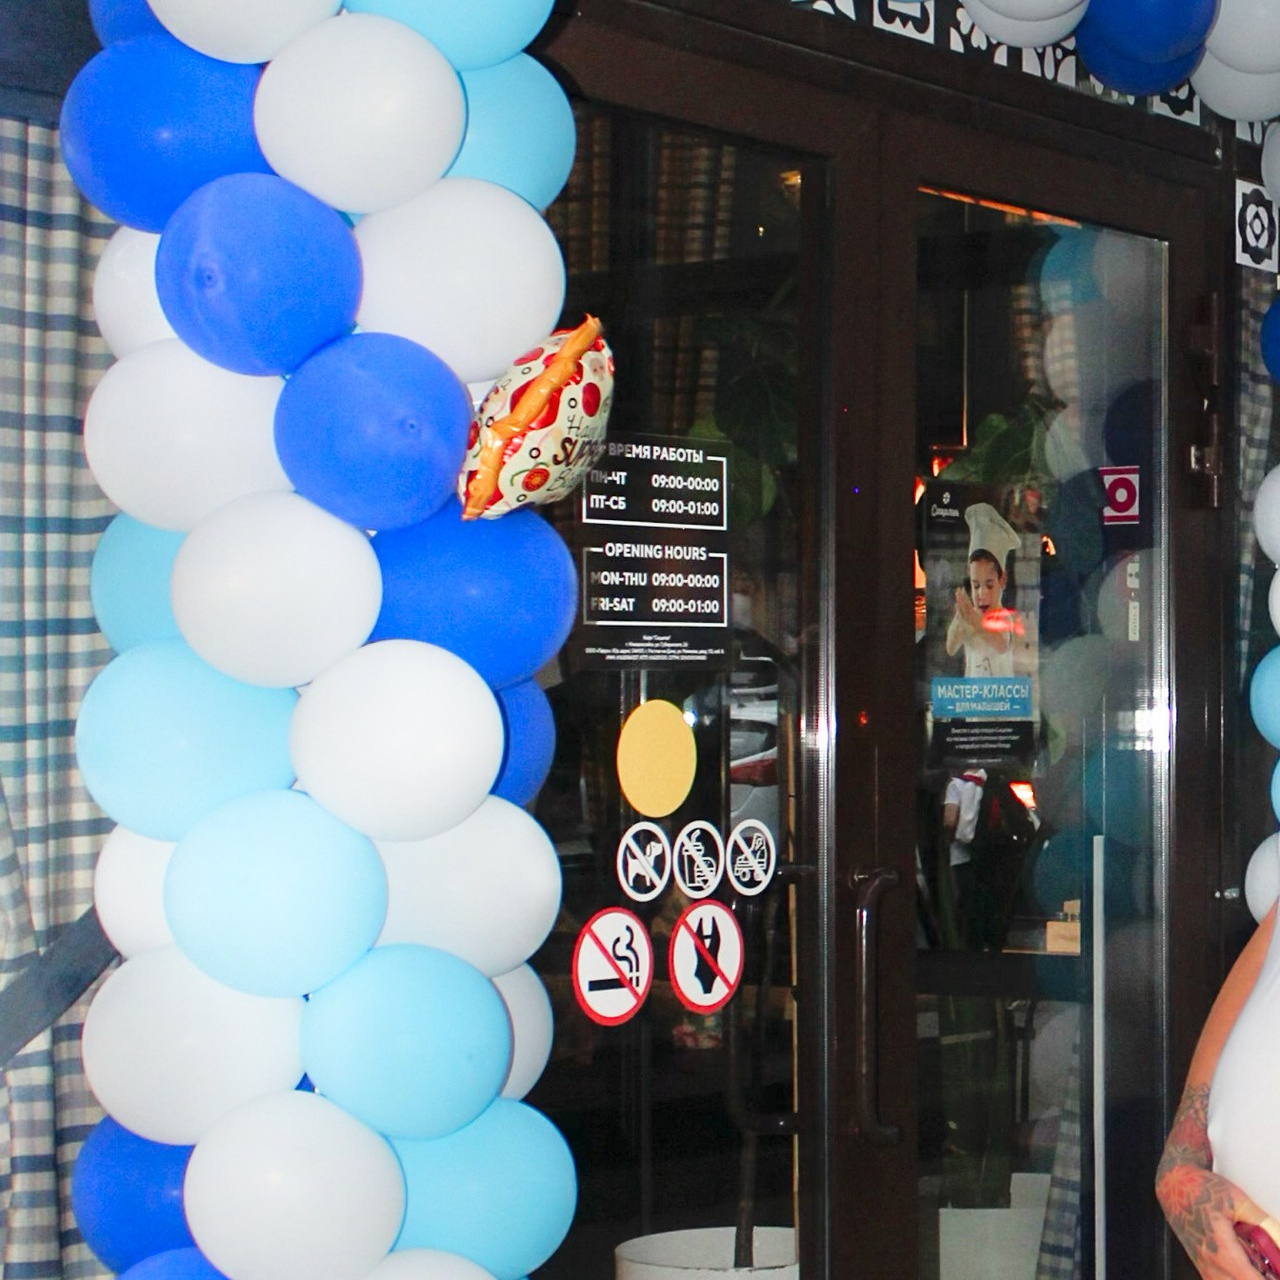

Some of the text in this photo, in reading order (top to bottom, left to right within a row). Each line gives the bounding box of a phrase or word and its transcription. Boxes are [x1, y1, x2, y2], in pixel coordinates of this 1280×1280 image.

[608, 442, 703, 464] ВРЕМЯ РАБОТЫ
[590, 470, 627, 486] ПН-ЧТ
[651, 474, 719, 492] 09:00-00:00
[590, 494, 719, 516] ПТ-СБ 09:00-01:00
[605, 543, 707, 561] OPENING HOURS
[590, 571, 719, 589] MON-THU 09:00-00:00
[590, 597, 719, 614] FRI-SAT 09:00-01:00
[937, 685, 1029, 699] МАСТЕР-КЛАССЫ
